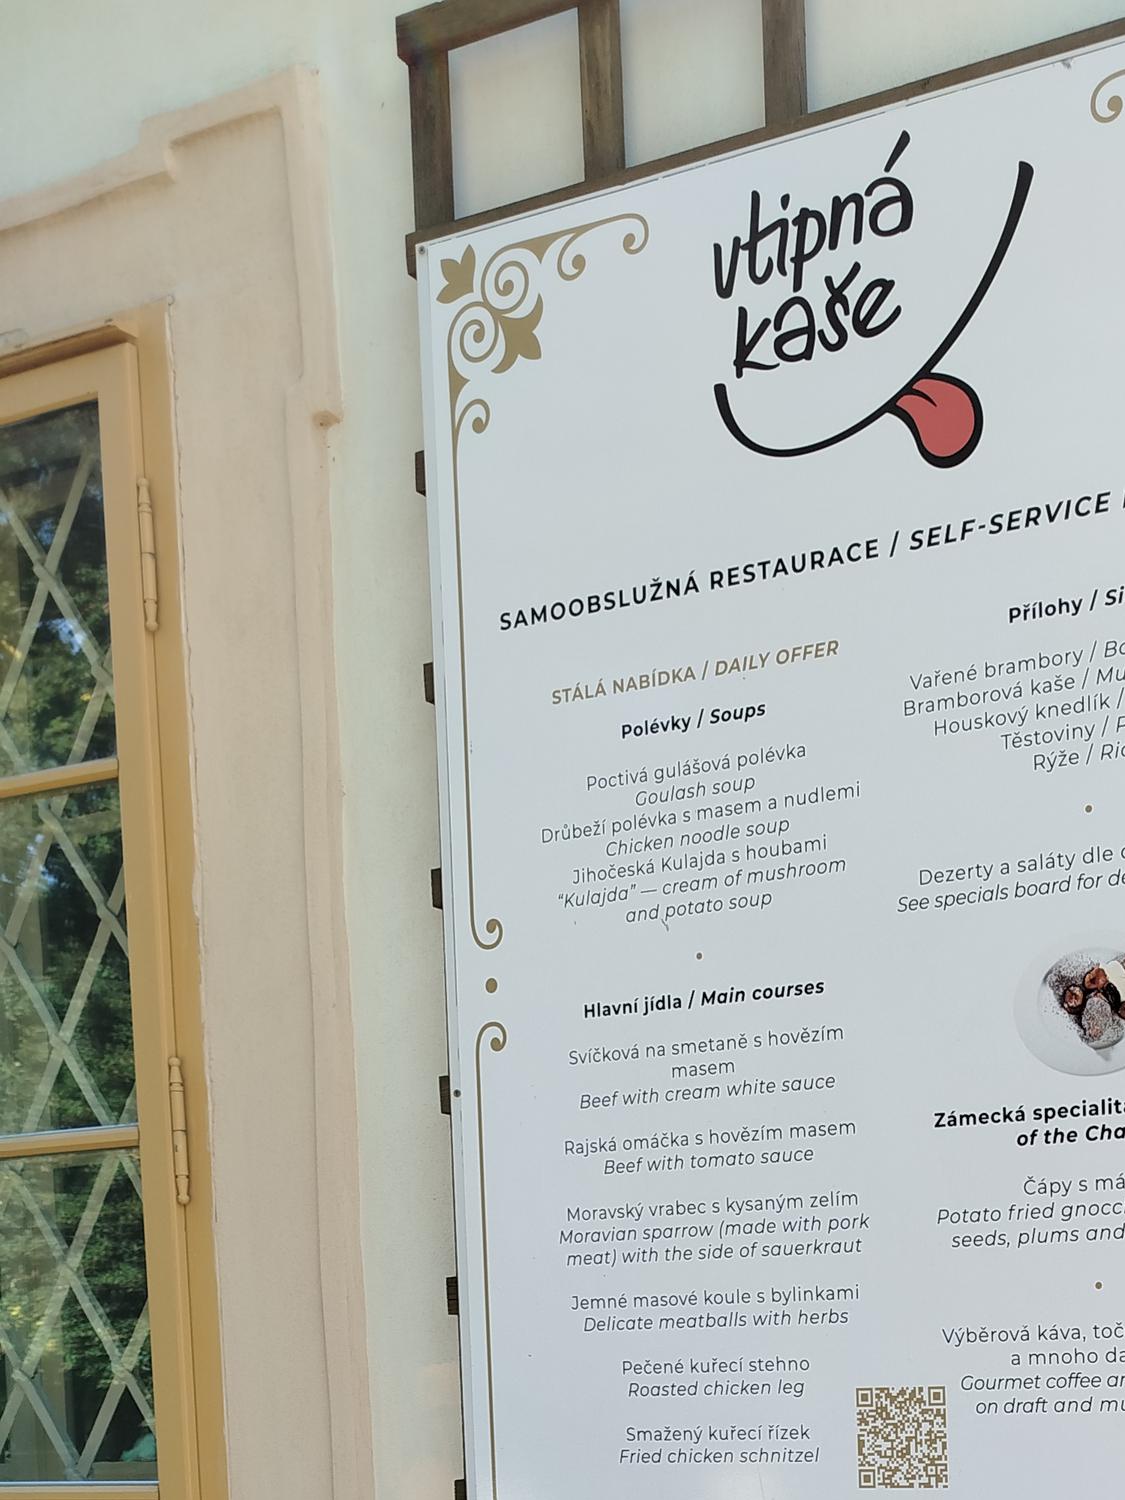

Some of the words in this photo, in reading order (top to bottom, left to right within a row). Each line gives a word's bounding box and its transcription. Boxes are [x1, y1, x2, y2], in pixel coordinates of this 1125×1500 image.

[713, 130, 914, 299] vtipná
[733, 261, 902, 379] kaše
[499, 569, 700, 631] SAMOOBSLUŽNÁ
[709, 538, 879, 591] RESTAURACE
[909, 491, 1111, 551] SELF-SERVICE
[1009, 597, 1083, 624] Přílohy
[551, 677, 607, 705] STÁLÁ
[612, 665, 697, 695] NABÍDKA
[714, 651, 771, 677] DAILY
[775, 639, 839, 665] OFFER
[909, 663, 978, 691] Vařené
[984, 649, 1084, 679] brambory
[903, 680, 1023, 717] Bramborová
[1030, 673, 1076, 696] kaše
[621, 715, 692, 739] Polévky
[709, 703, 766, 725] Soups
[934, 705, 1029, 737] Houskový
[1035, 692, 1111, 721] knedlík
[1000, 723, 1096, 751] Těstoviny
[586, 766, 648, 791] Poctivá
[653, 753, 731, 785] gulášová
[737, 743, 806, 772] polévka
[1033, 749, 1080, 773] Rýže
[635, 781, 706, 807] Goulash
[711, 777, 756, 795] soup
[605, 835, 674, 857] Chicken
[679, 823, 741, 847] noodle
[745, 819, 790, 837] soup
[662, 876, 718, 896] cream
[723, 868, 743, 887] of
[746, 859, 846, 885] mushroom
[625, 903, 660, 923] and
[664, 898, 724, 922] potato
[728, 893, 773, 910] soup
[583, 997, 639, 1019] Hlavní
[642, 994, 682, 1017] jídla
[701, 986, 746, 1007] Main
[751, 981, 825, 1001] courses
[671, 1061, 735, 1079] masem
[933, 1105, 1026, 1128] Zámecká
[1016, 1128, 1039, 1147] of
[1043, 1127, 1078, 1145] the
[603, 1156, 644, 1175] Beef
[646, 1153, 684, 1172] with
[690, 1151, 755, 1169] tomato
[759, 1149, 814, 1165] sauce
[937, 1207, 1002, 1225] Potato
[1008, 1201, 1055, 1221] fried
[559, 1225, 637, 1245] Moravian
[642, 1224, 714, 1244] sparrow
[719, 1217, 777, 1240] (made
[782, 1215, 822, 1233] with
[827, 1212, 870, 1235] pork
[951, 1229, 1011, 1249] seeds,
[1017, 1227, 1080, 1249] plums
[583, 1315, 654, 1332] Delicate
[658, 1311, 747, 1330] meatballs
[752, 1309, 792, 1327] with
[797, 1307, 849, 1325] herbs
[1037, 1323, 1087, 1343] káva,
[622, 1358, 685, 1375] Pečené
[689, 1356, 744, 1374] kuřecí
[748, 1355, 810, 1373] stehno
[628, 1380, 699, 1397] Roasted
[703, 1379, 771, 1396] chicken
[777, 1378, 805, 1398] leg
[960, 1374, 1042, 1391] Gourmet
[1045, 1371, 1102, 1389] coffee
[626, 1425, 703, 1445] Smažený
[708, 1424, 763, 1441] kuřecí
[767, 1423, 811, 1441] řízek
[619, 1447, 663, 1464] Fried
[667, 1447, 734, 1464] chicken
[738, 1447, 820, 1463] schnitzel
